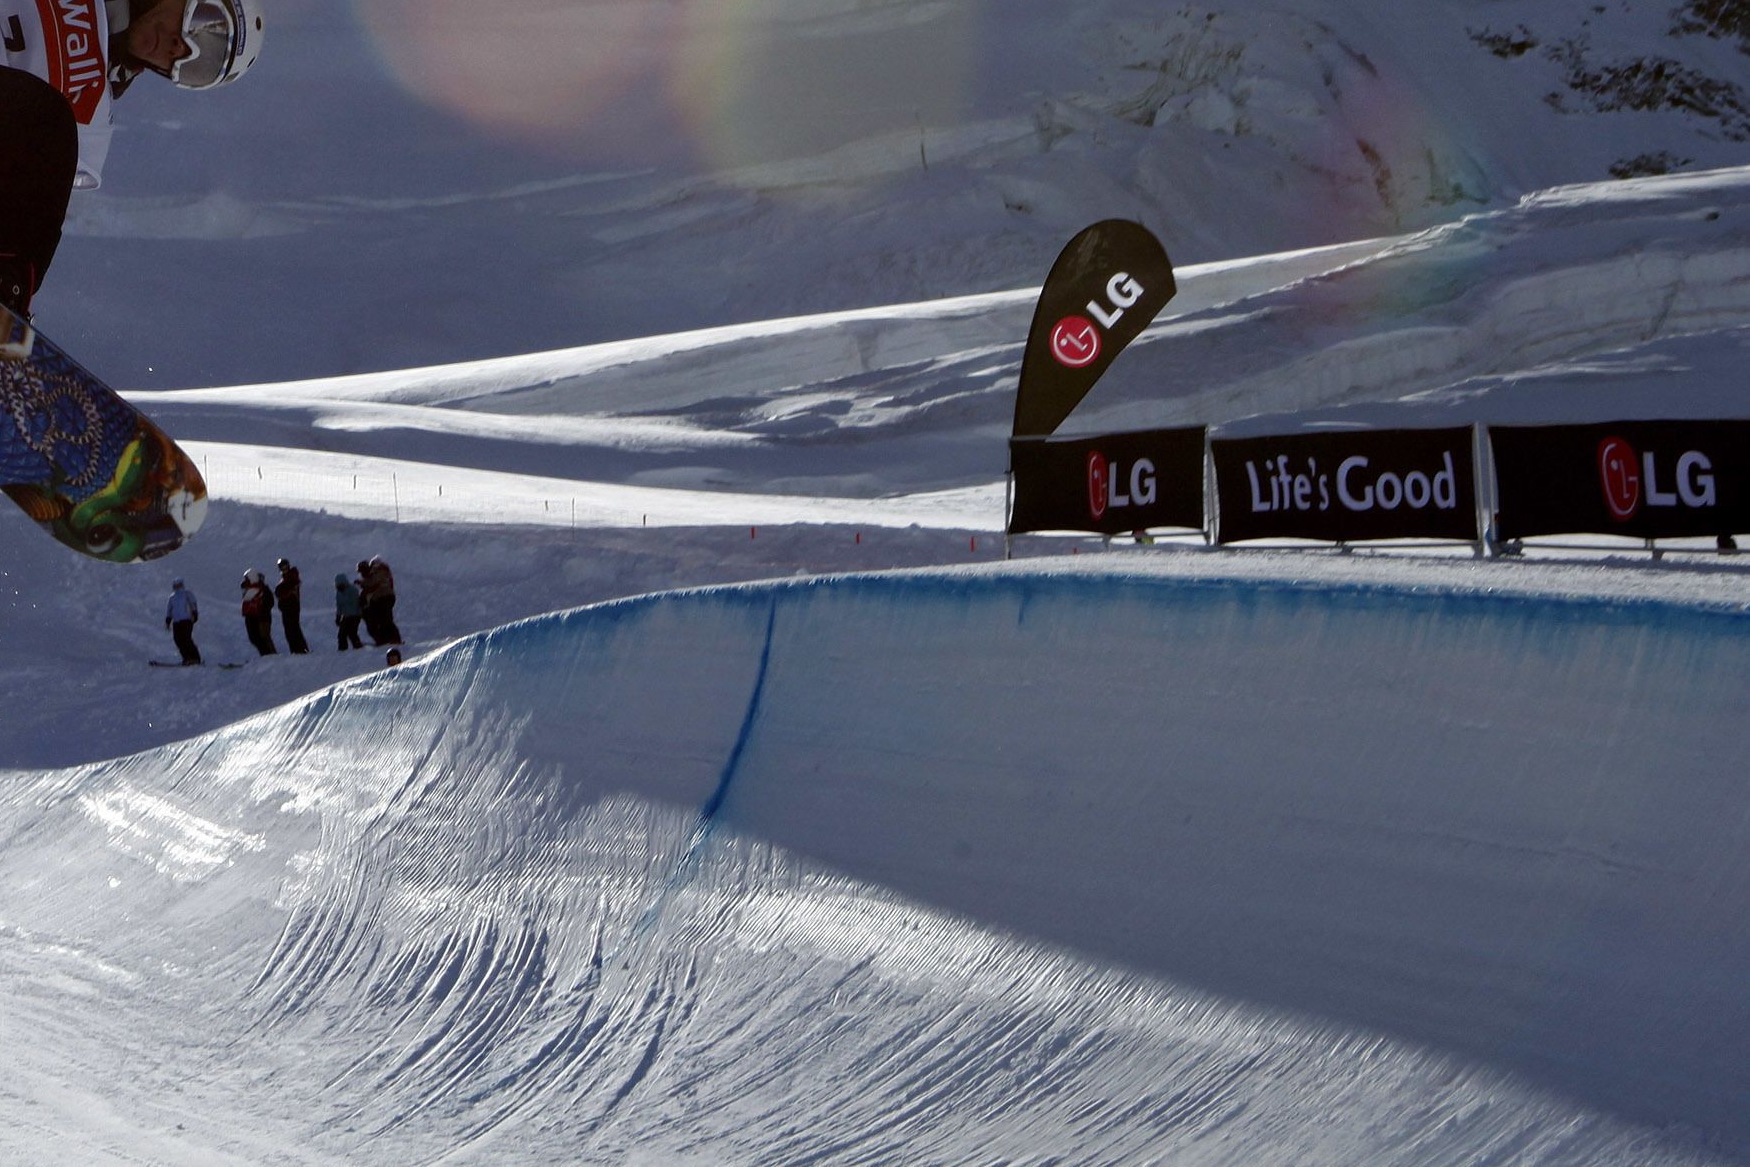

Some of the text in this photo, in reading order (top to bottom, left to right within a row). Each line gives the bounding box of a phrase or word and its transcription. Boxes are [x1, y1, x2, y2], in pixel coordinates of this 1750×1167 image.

[1086, 271, 1144, 330] LG
[1109, 458, 1156, 507] LG
[1246, 451, 1455, 513] Life's Good
[1645, 451, 1716, 508] LG
